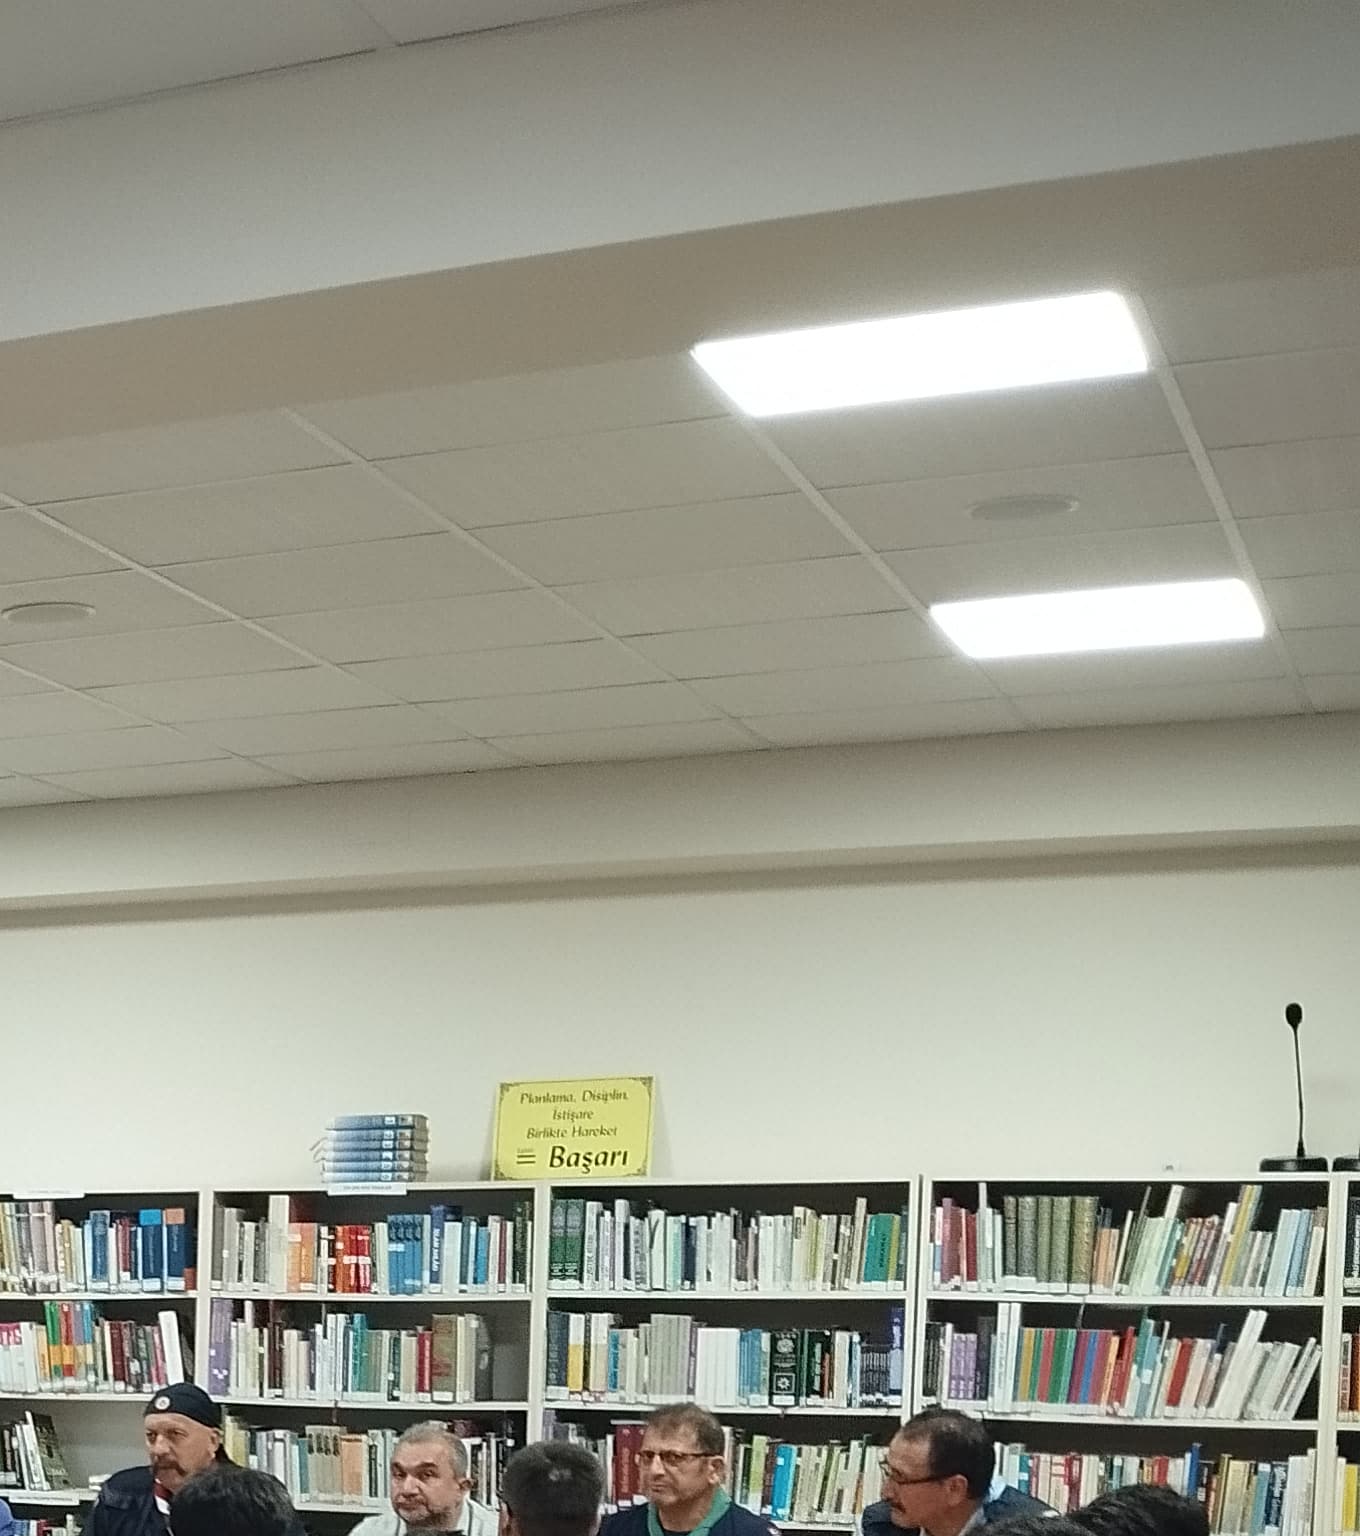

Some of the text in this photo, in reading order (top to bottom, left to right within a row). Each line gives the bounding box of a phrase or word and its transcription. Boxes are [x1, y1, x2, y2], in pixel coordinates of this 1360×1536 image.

[526, 1124, 618, 1139] Birlikte Hareket
[549, 1145, 628, 1174] Başarı
